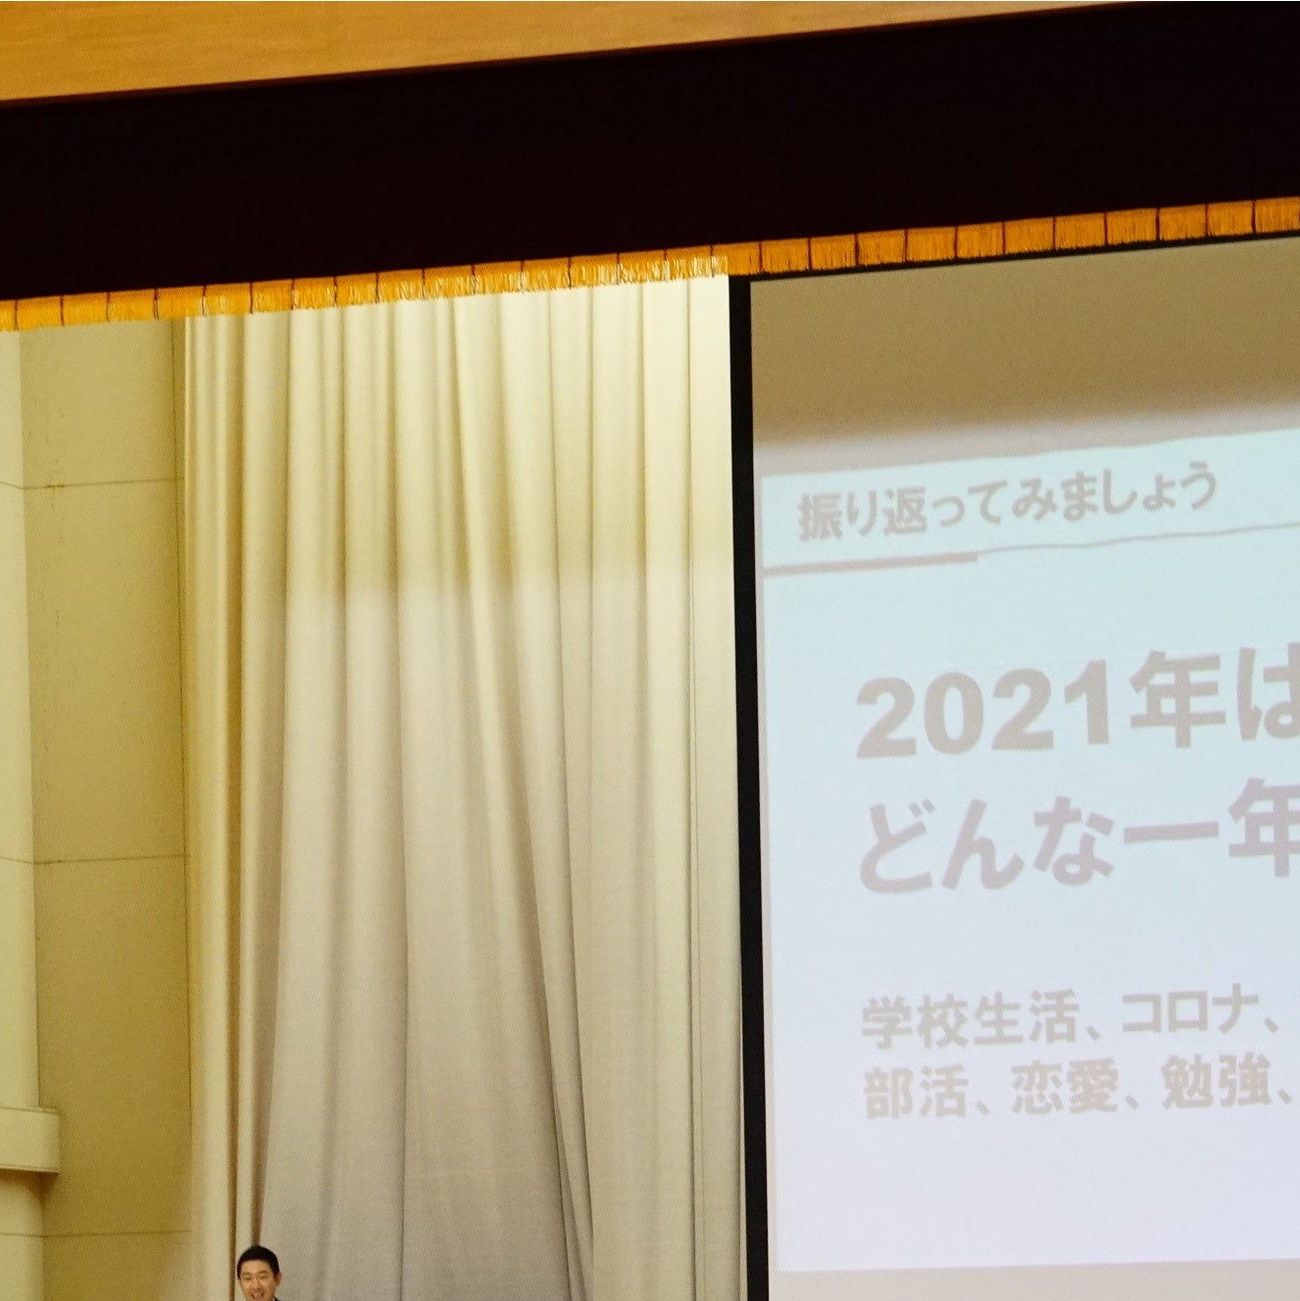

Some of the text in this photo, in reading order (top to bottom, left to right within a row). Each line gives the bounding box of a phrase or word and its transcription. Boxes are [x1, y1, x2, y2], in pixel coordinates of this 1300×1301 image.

[797, 459, 1218, 543] 振り返ってみましょう
